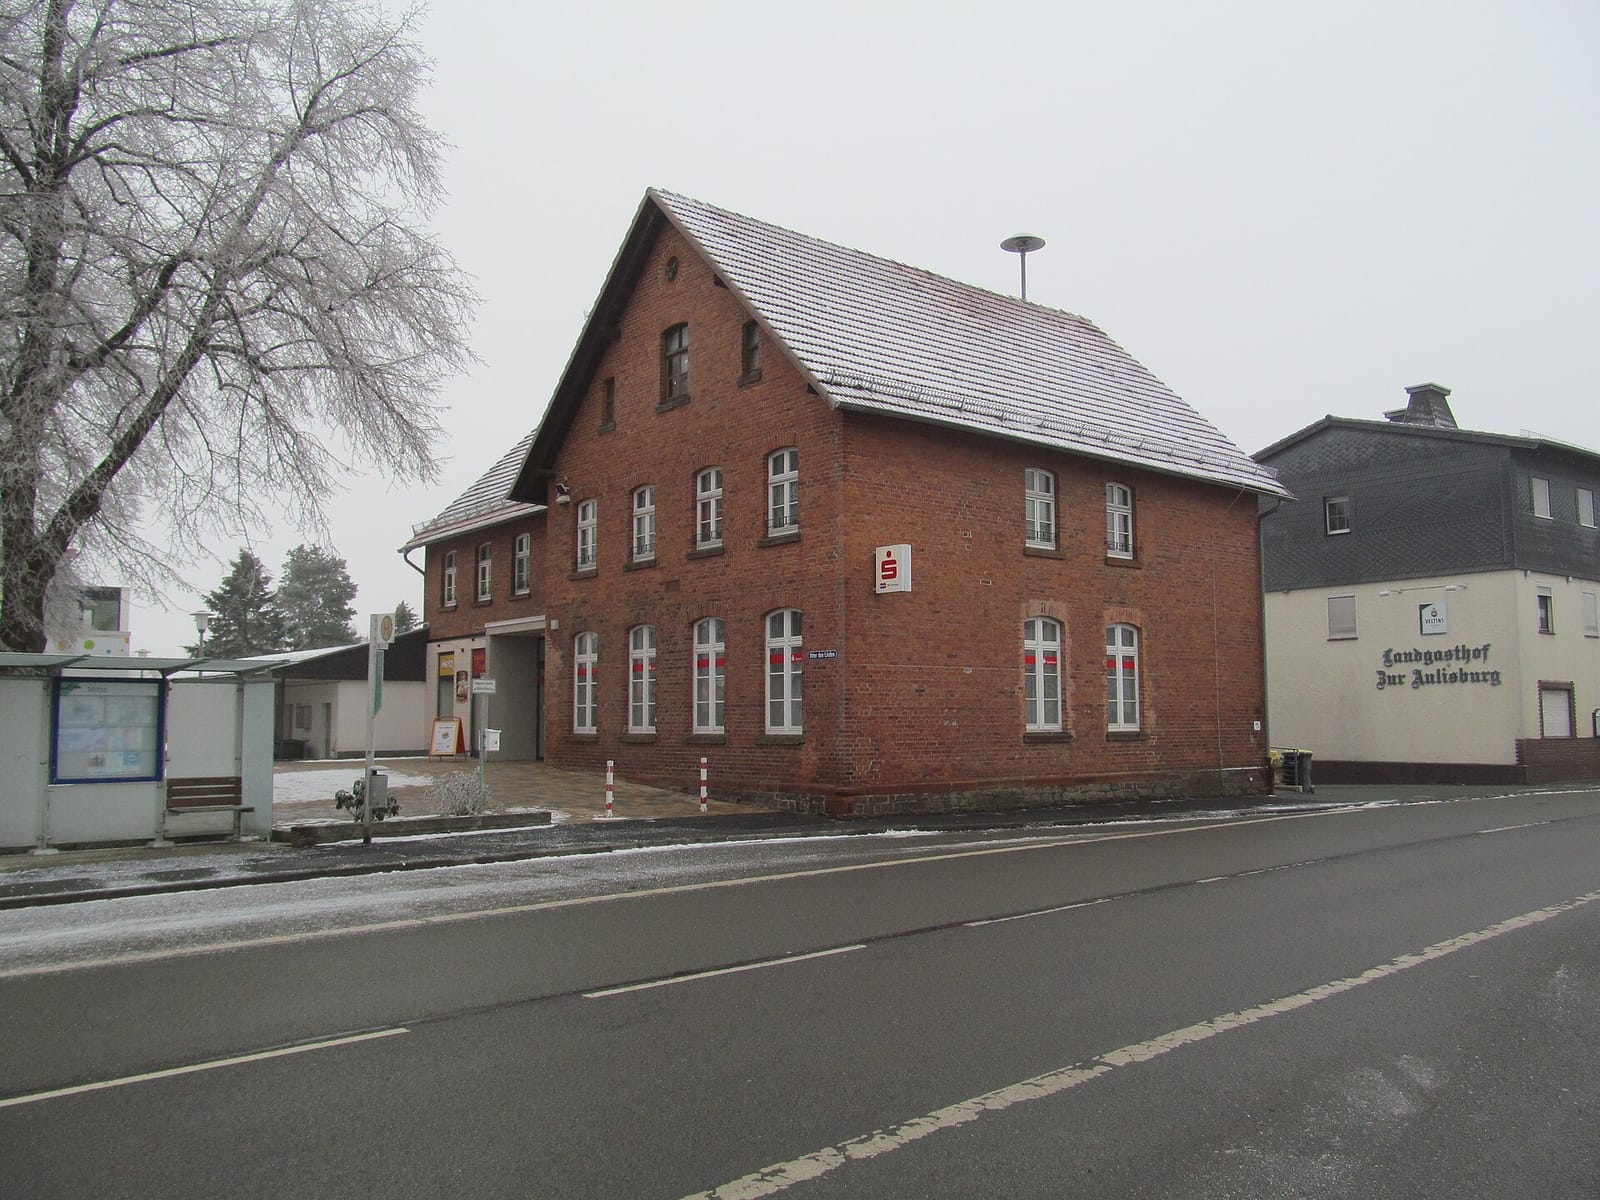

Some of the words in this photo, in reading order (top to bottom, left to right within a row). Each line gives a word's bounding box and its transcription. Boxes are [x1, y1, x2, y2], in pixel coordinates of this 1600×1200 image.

[881, 559, 897, 580] S
[1383, 643, 1491, 667] Landgasthof
[1376, 670, 1406, 690] Zur
[1411, 667, 1502, 689] Aulisburg
